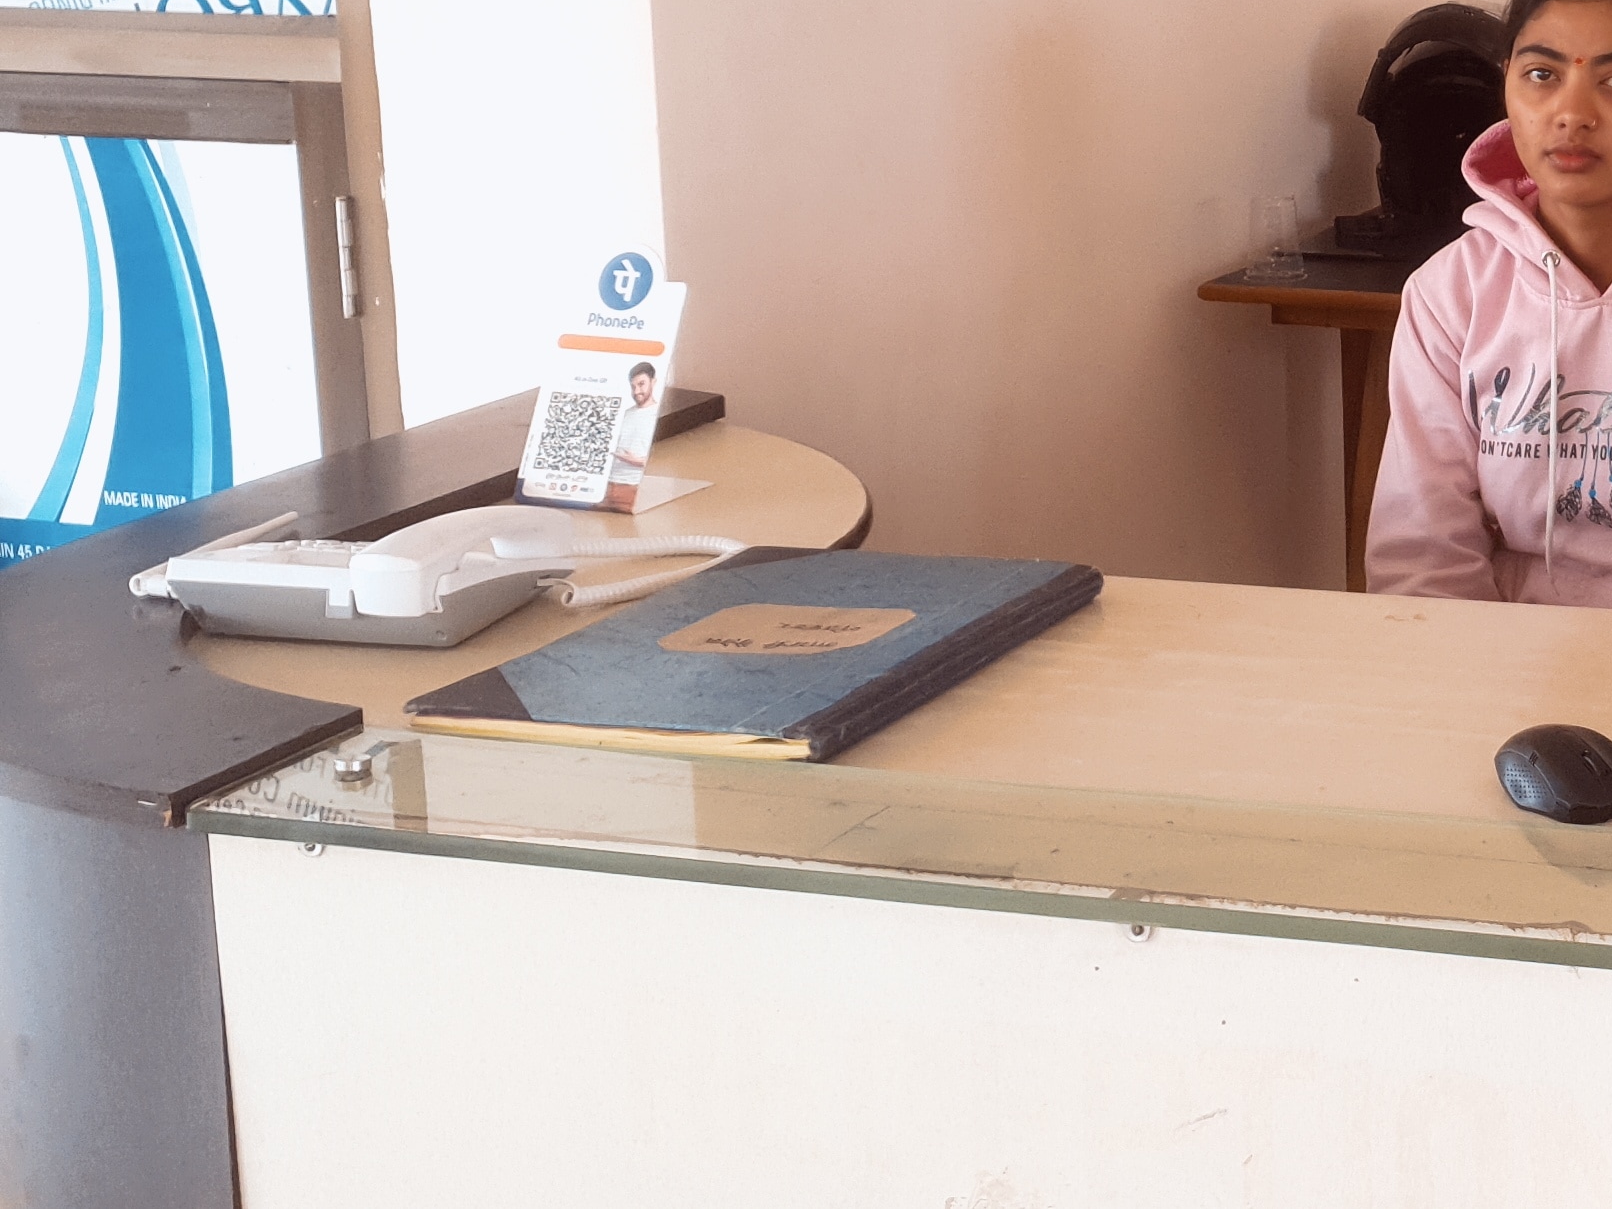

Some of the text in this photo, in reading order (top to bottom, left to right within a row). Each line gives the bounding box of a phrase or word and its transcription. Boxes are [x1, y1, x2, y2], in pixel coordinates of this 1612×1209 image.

[587, 312, 645, 330] PhonePe
[1547, 443, 1586, 459] HAT
[103, 489, 139, 508] MADE
[140, 493, 154, 509] IN
